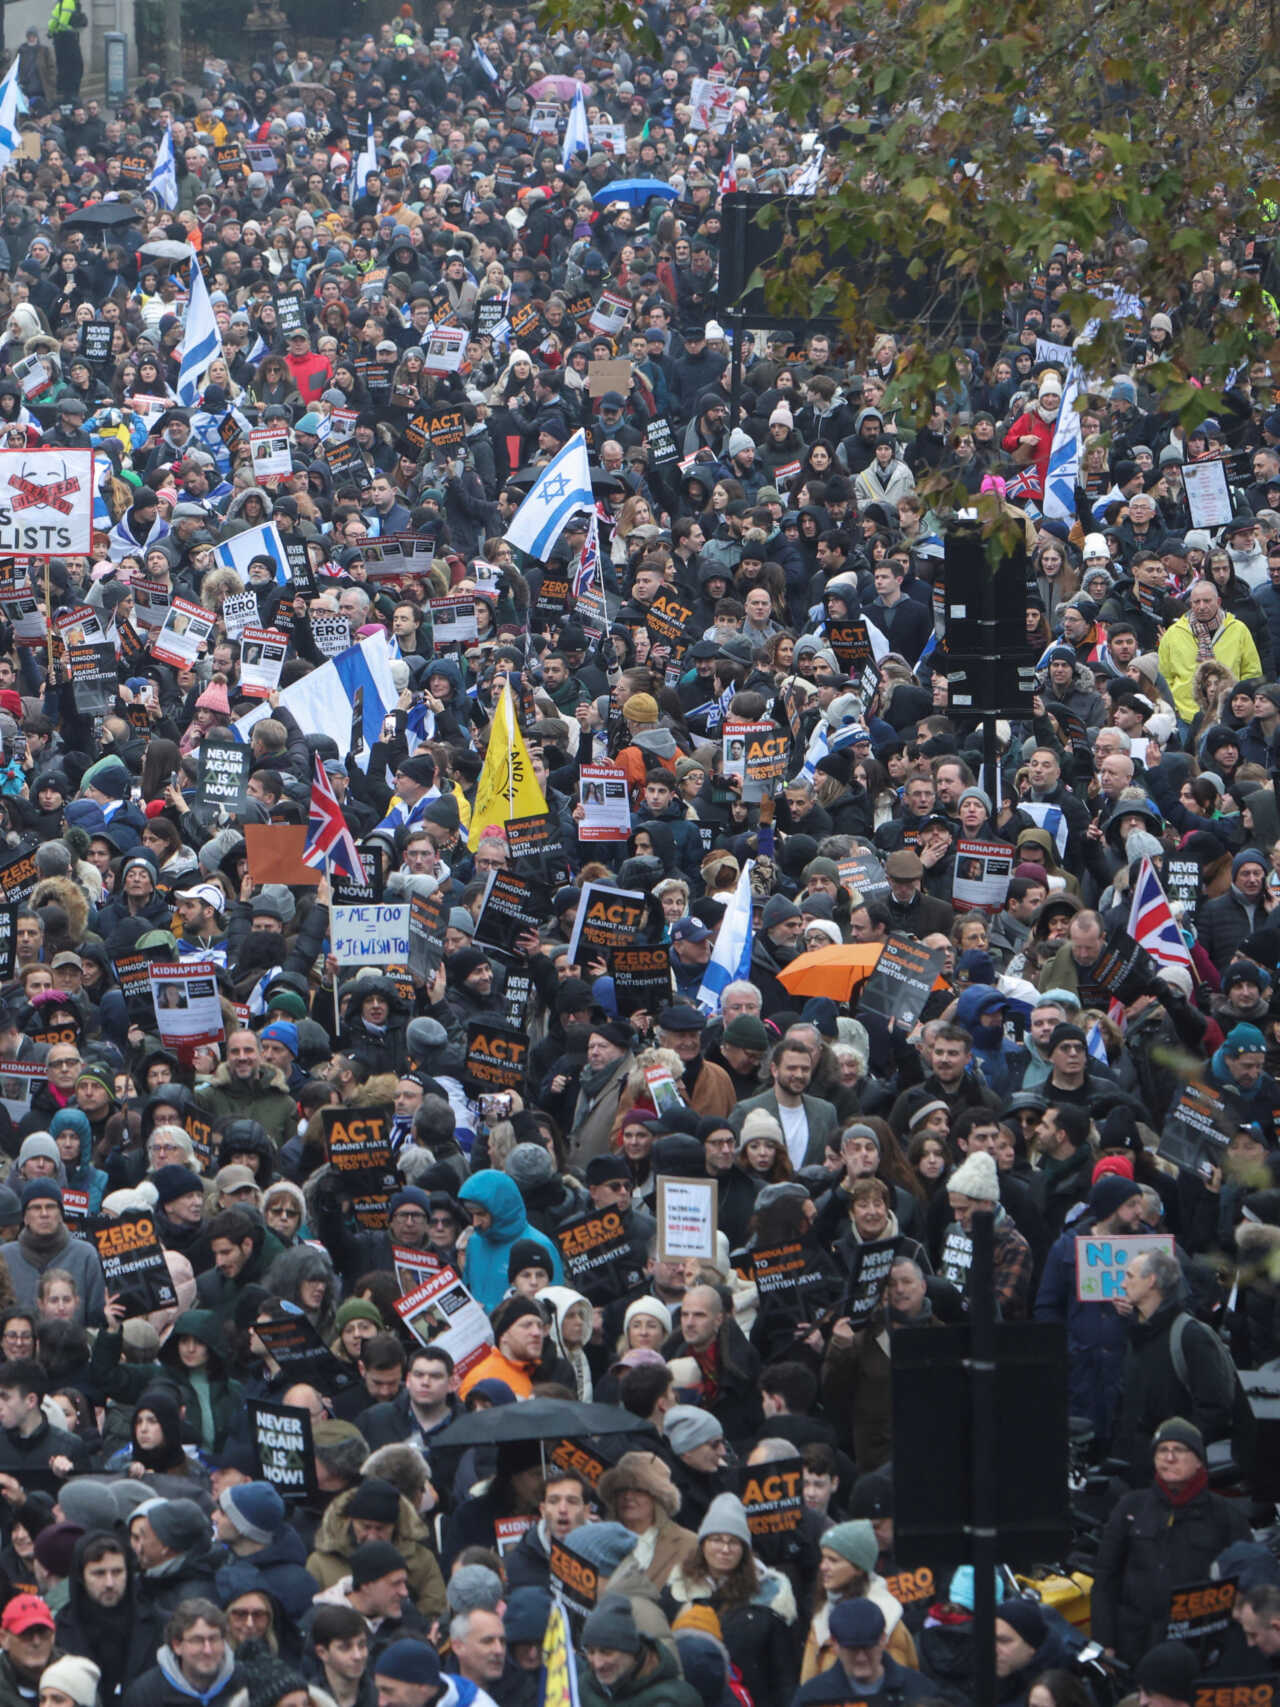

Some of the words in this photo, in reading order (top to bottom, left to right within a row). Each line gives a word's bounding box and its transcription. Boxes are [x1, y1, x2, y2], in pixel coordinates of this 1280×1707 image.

[430, 413, 461, 432] ACT
[225, 600, 255, 615] ZERO
[652, 597, 692, 623] ACT
[831, 628, 864, 642] ACT
[725, 724, 772, 734] KIDNAPPED
[208, 748, 242, 762] NEVER
[748, 737, 788, 760] ACT
[206, 760, 242, 774] AGAIN
[218, 774, 228, 784] IS
[206, 784, 239, 797] NOW!
[511, 843, 530, 851] WITH
[960, 843, 1012, 854] KIDNAPPED
[1169, 862, 1198, 873] NEVER
[1168, 874, 1198, 886] AGAIN
[339, 886, 373, 898] NOW!
[1179, 886, 1188, 898] IS
[375, 906, 402, 921] TOO
[588, 902, 639, 925] ACT
[614, 950, 668, 967] ZERO
[153, 965, 211, 976] KIDNAPPED
[507, 976, 530, 988] NEVER
[506, 990, 528, 1002] AGAIN
[469, 1034, 524, 1062] ACT
[330, 1119, 384, 1145] ACT
[331, 1142, 364, 1151] AGAINST
[365, 1141, 388, 1149] HATE
[96, 1218, 153, 1248] ZERO
[558, 1214, 620, 1248] ZERO
[102, 1256, 120, 1270] FOR
[105, 1255, 162, 1278] ANTISEMITES
[568, 1254, 588, 1270] FOR
[755, 1260, 768, 1268] TO
[758, 1273, 782, 1284] WITH
[398, 1270, 452, 1312] KIDNAPPED
[256, 1410, 302, 1434] NEVER
[258, 1429, 304, 1452] AGAIN
[272, 1450, 286, 1468] IS
[262, 1465, 304, 1484] NOW!
[742, 1472, 800, 1504] ACT
[552, 1545, 595, 1589] ZERO
[1172, 1584, 1234, 1612] ZERO
